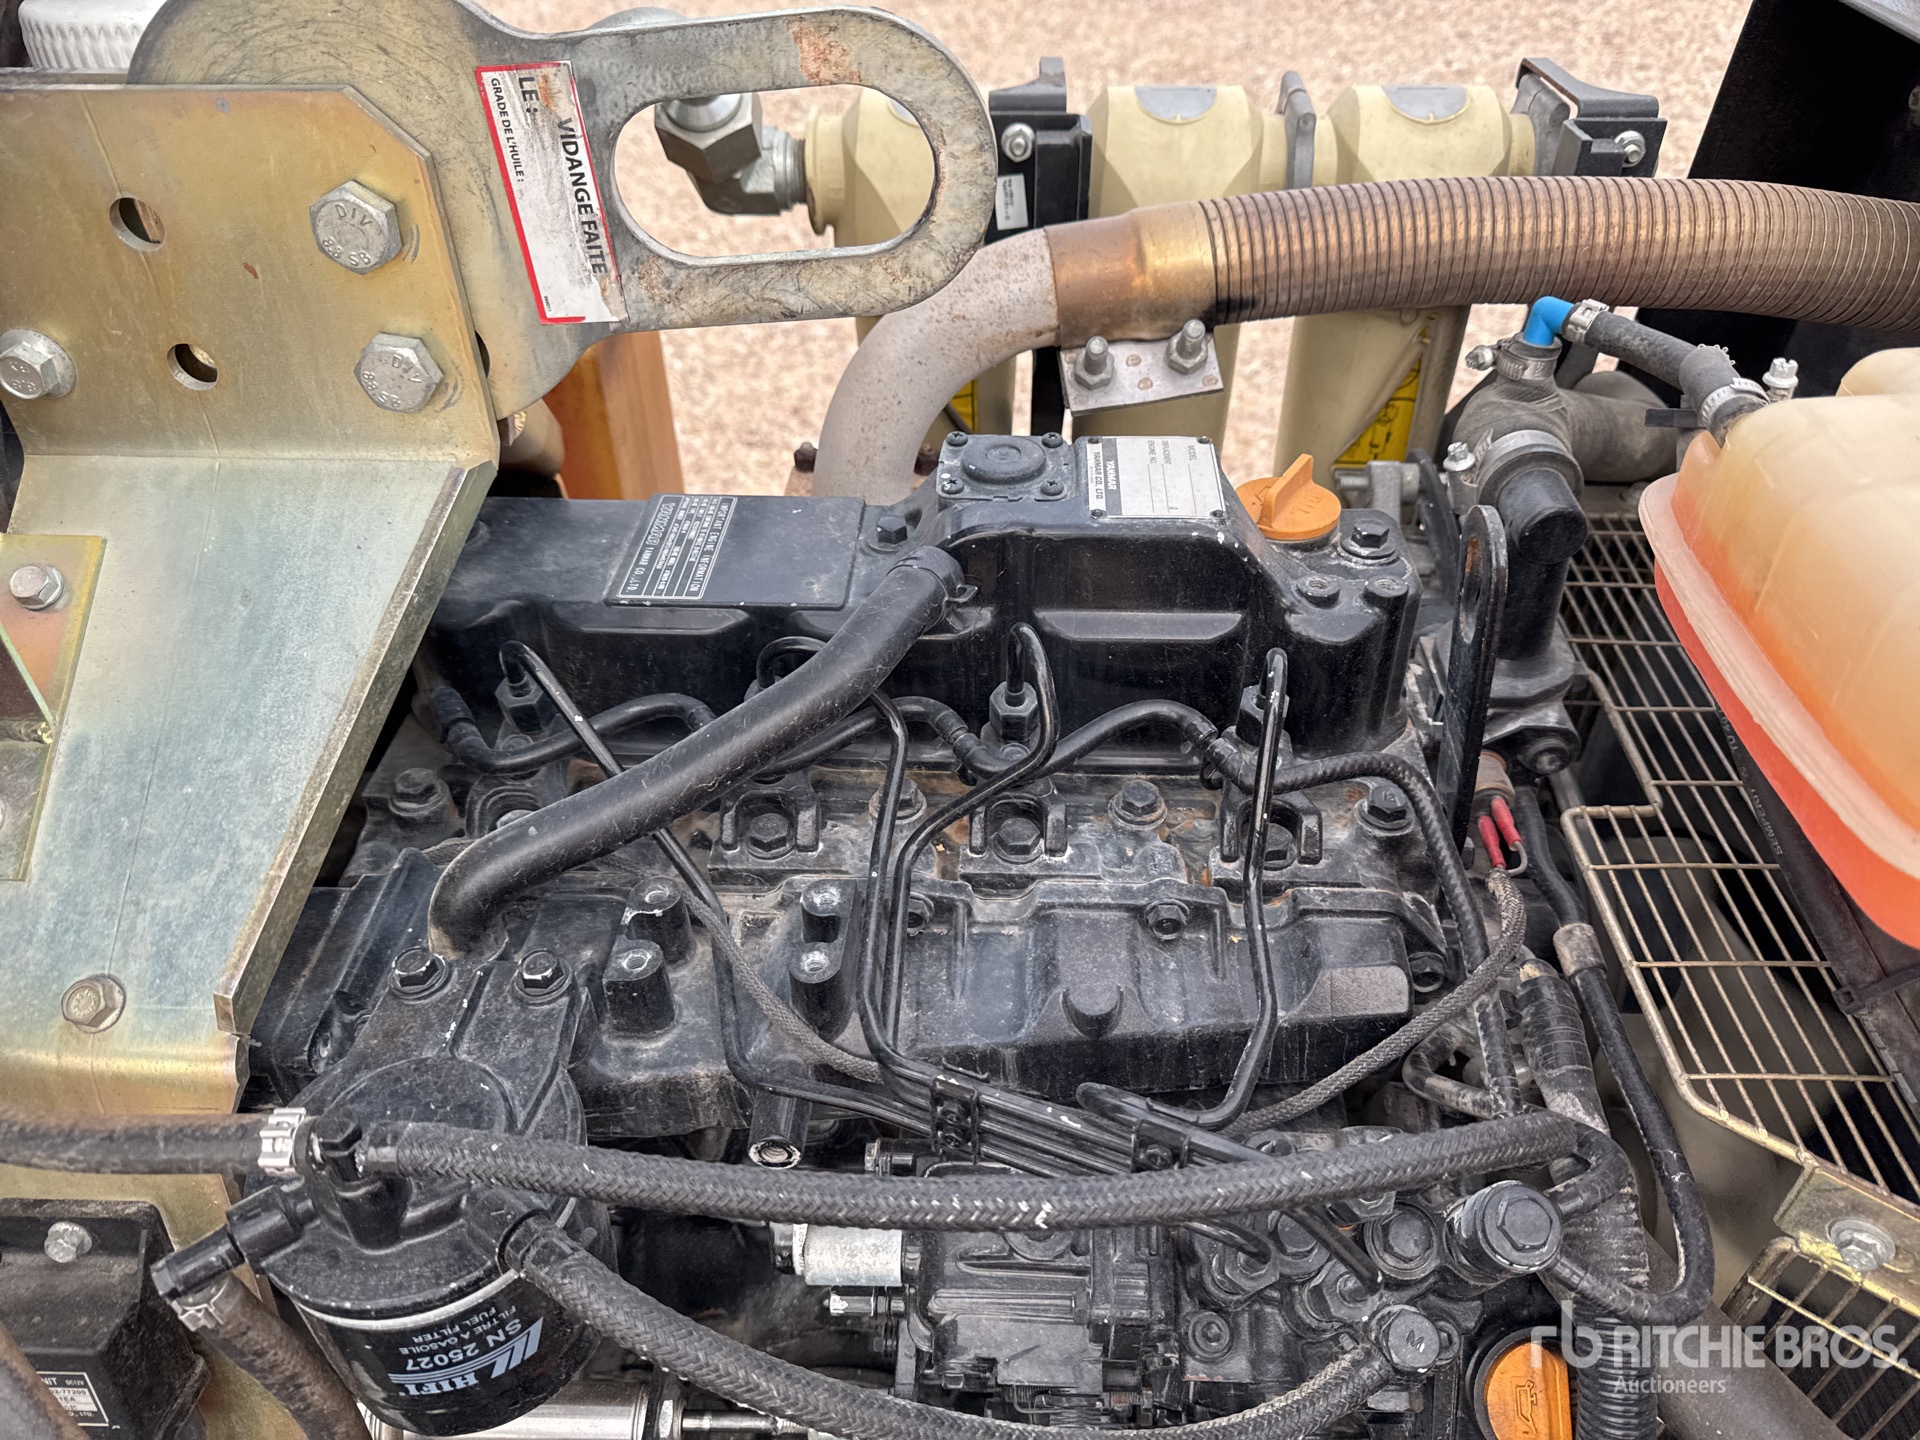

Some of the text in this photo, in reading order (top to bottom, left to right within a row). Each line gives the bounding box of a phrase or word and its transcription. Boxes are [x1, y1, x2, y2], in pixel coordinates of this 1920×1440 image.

[490, 77, 509, 117] GRADE
[519, 76, 540, 101] LE
[502, 120, 513, 136] DE
[506, 136, 525, 177] L'HUILE
[557, 117, 608, 274] VIDANGE FAITE
[1093, 451, 1102, 475] YANMAR
[1106, 460, 1117, 490] YANMAR
[703, 531, 720, 552] ENGINE
[689, 554, 713, 592] INFORMATION
[398, 1304, 517, 1355] FILTRE A GASOILE
[412, 1306, 497, 1344] FUEL FILTER
[405, 1318, 522, 1372] SN 25027
[403, 1371, 479, 1396] HIFI
